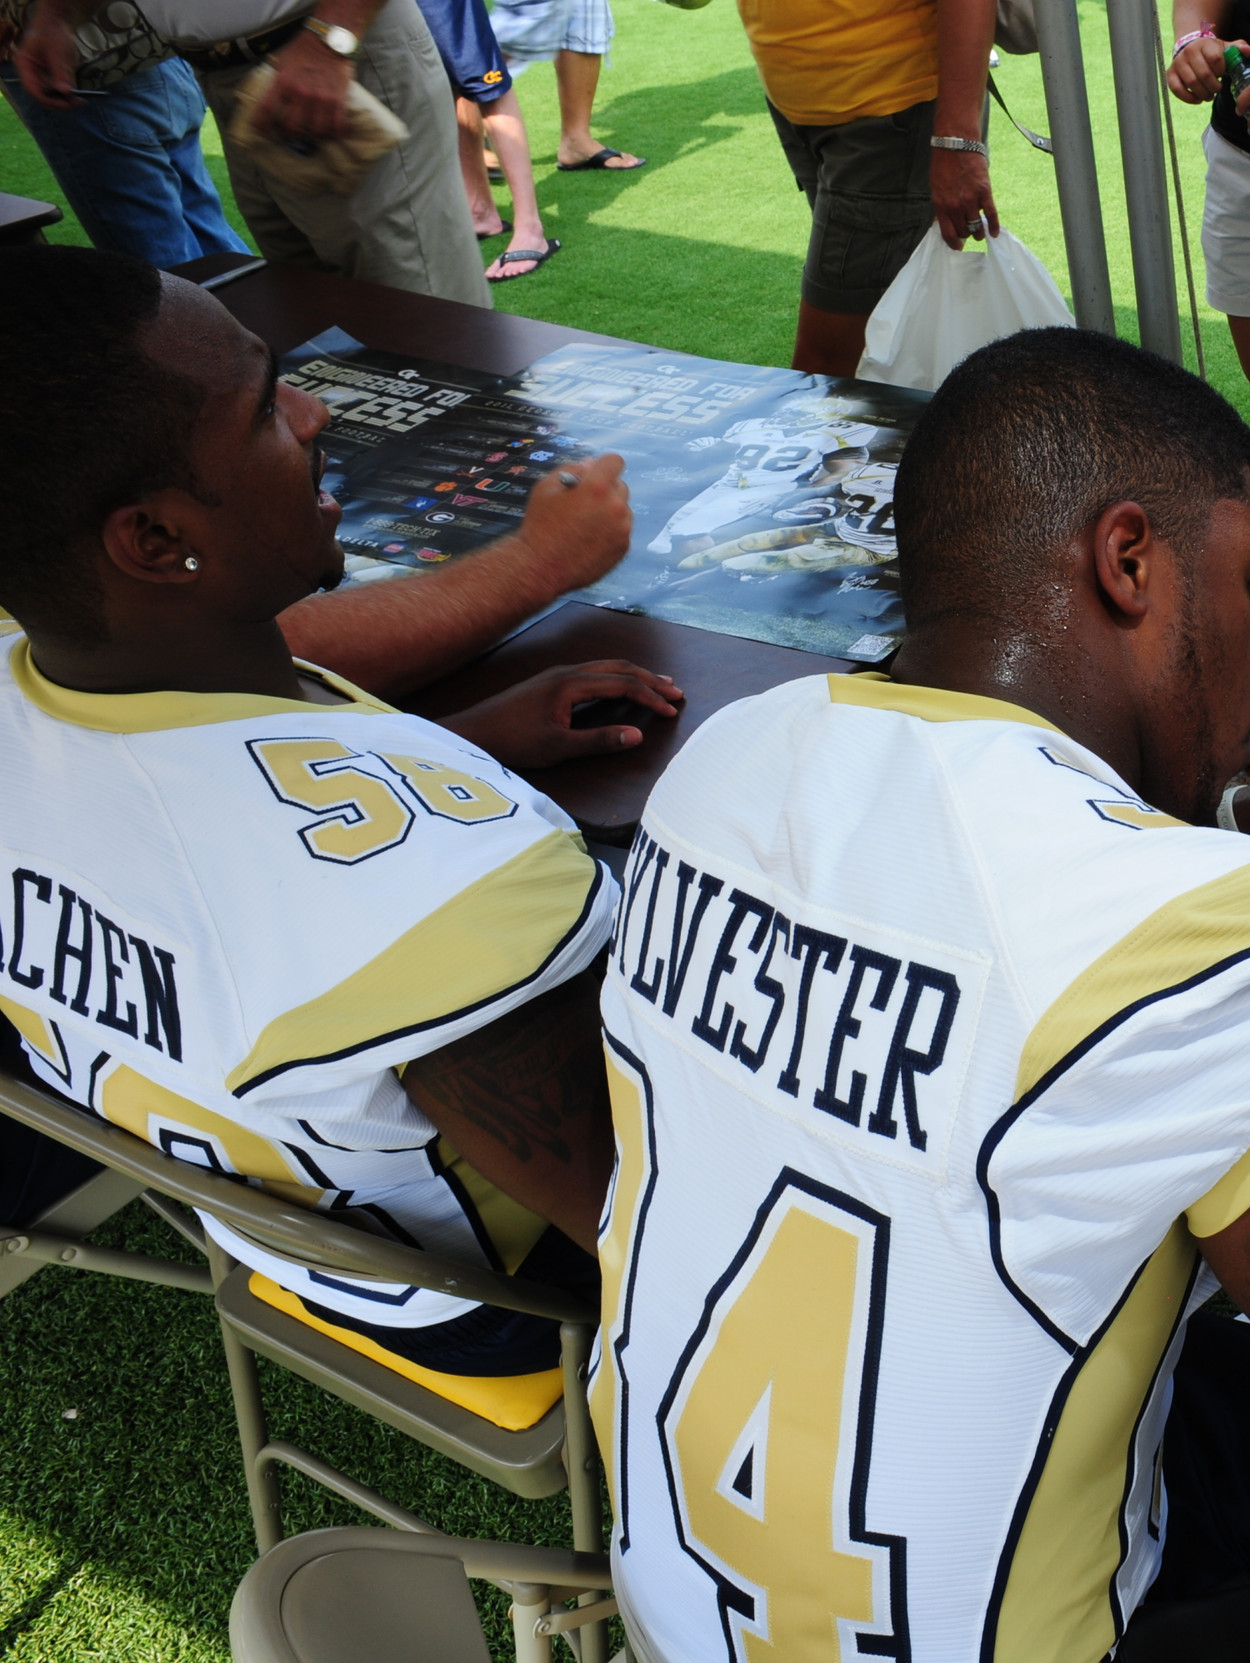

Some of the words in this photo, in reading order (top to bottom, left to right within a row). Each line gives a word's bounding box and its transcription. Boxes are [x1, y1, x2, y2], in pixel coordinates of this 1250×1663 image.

[298, 359, 430, 399] ENGINEERED
[503, 374, 733, 425] SUCCESS
[700, 382, 758, 401] FOR
[245, 737, 519, 865] 58
[0, 867, 183, 1063] CHEN
